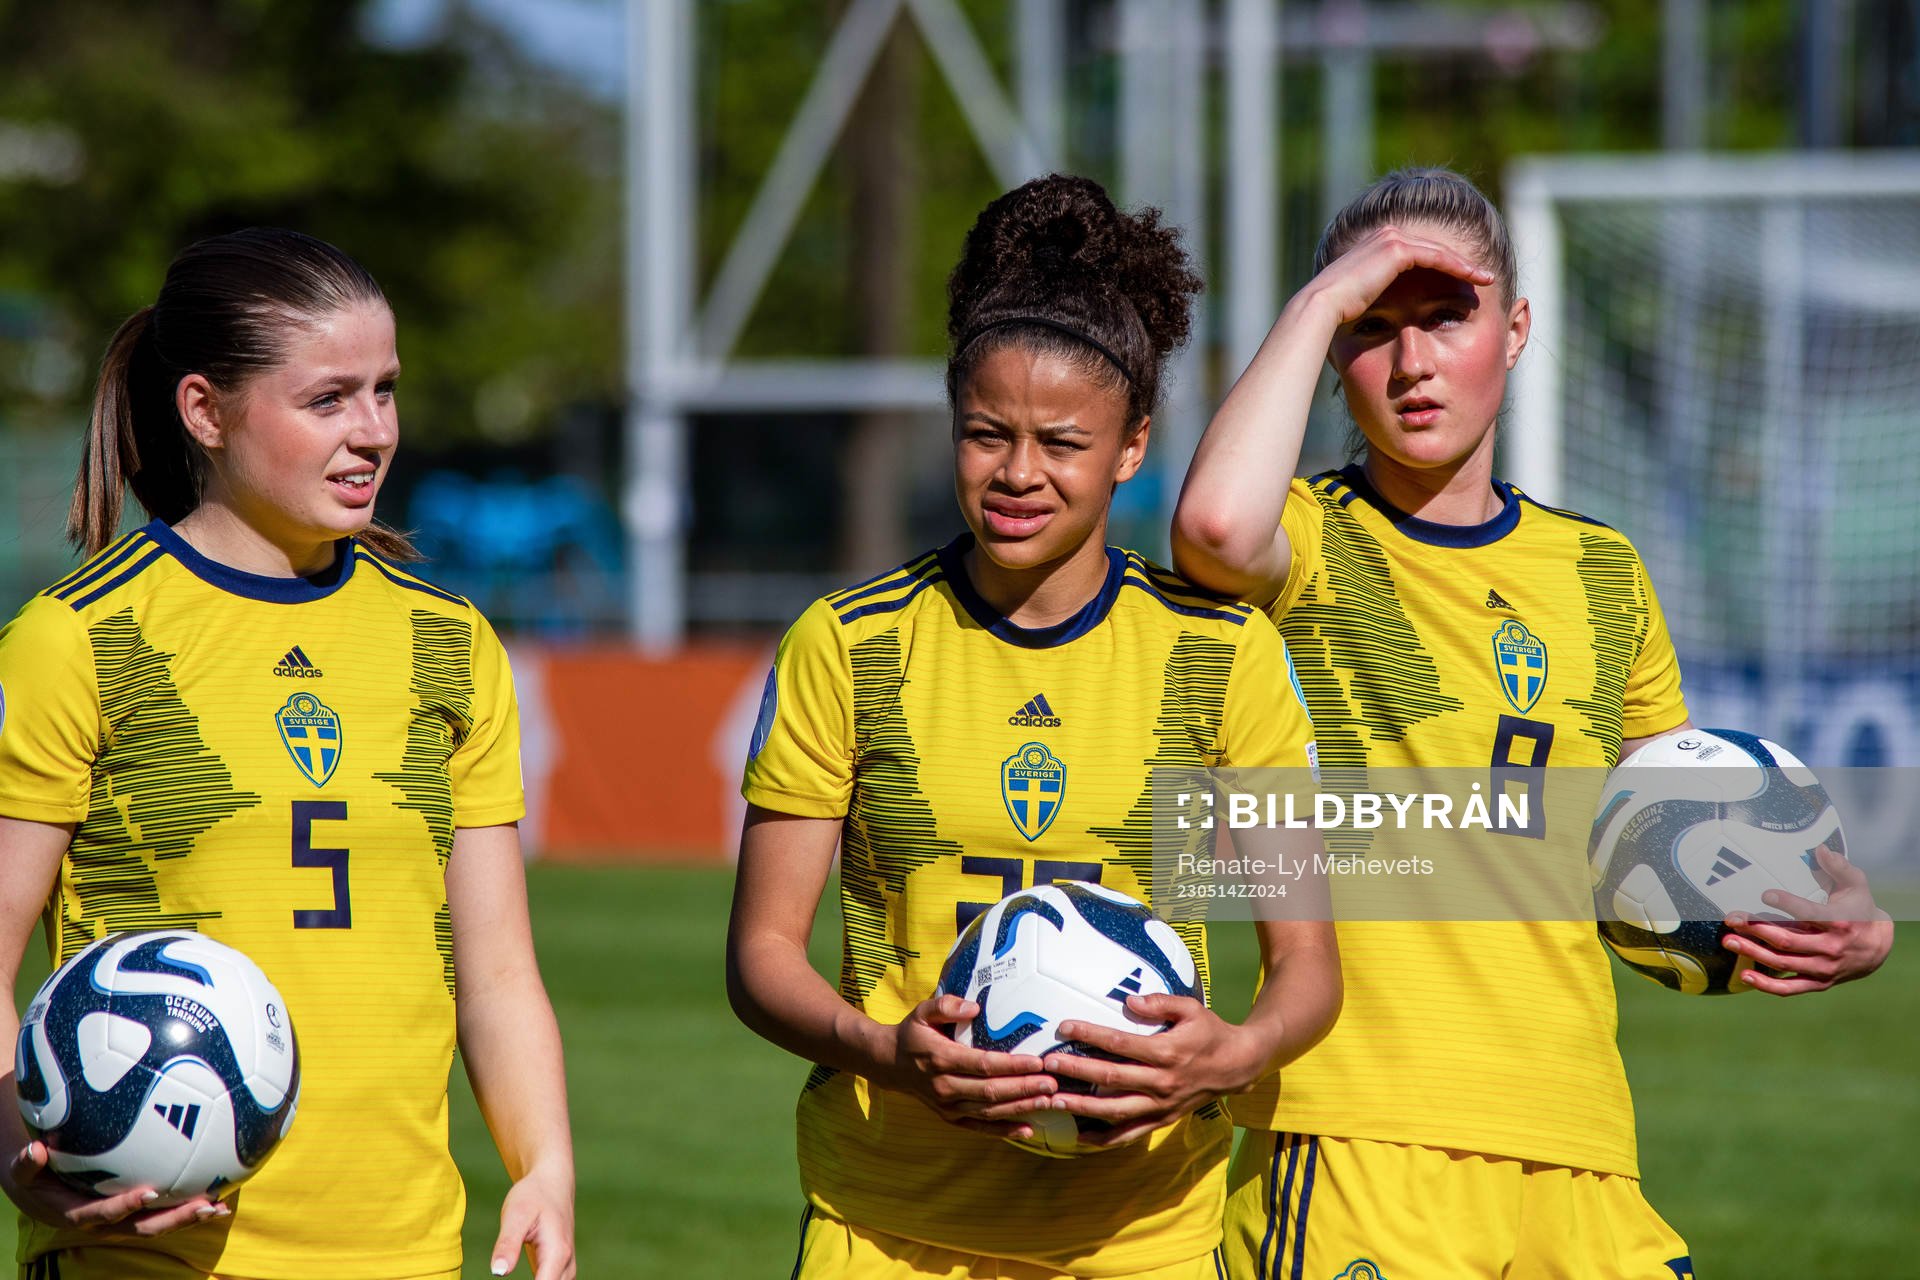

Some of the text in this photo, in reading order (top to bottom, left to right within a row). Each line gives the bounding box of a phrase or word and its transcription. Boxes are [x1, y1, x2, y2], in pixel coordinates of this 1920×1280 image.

[1503, 644, 1537, 655] SVERIGE
[273, 666, 323, 678] adidas
[289, 718, 329, 726] SVERIGE
[1008, 715, 1062, 728] adidas
[1014, 769, 1055, 779] SVERIGE
[1486, 714, 1554, 840] 8
[1621, 803, 1665, 841] OCEAUNZ
[1631, 815, 1663, 844] TRAINING
[291, 801, 352, 929] 5
[165, 995, 219, 1031] OCEAUNZ
[167, 1006, 207, 1034] TRAINING
